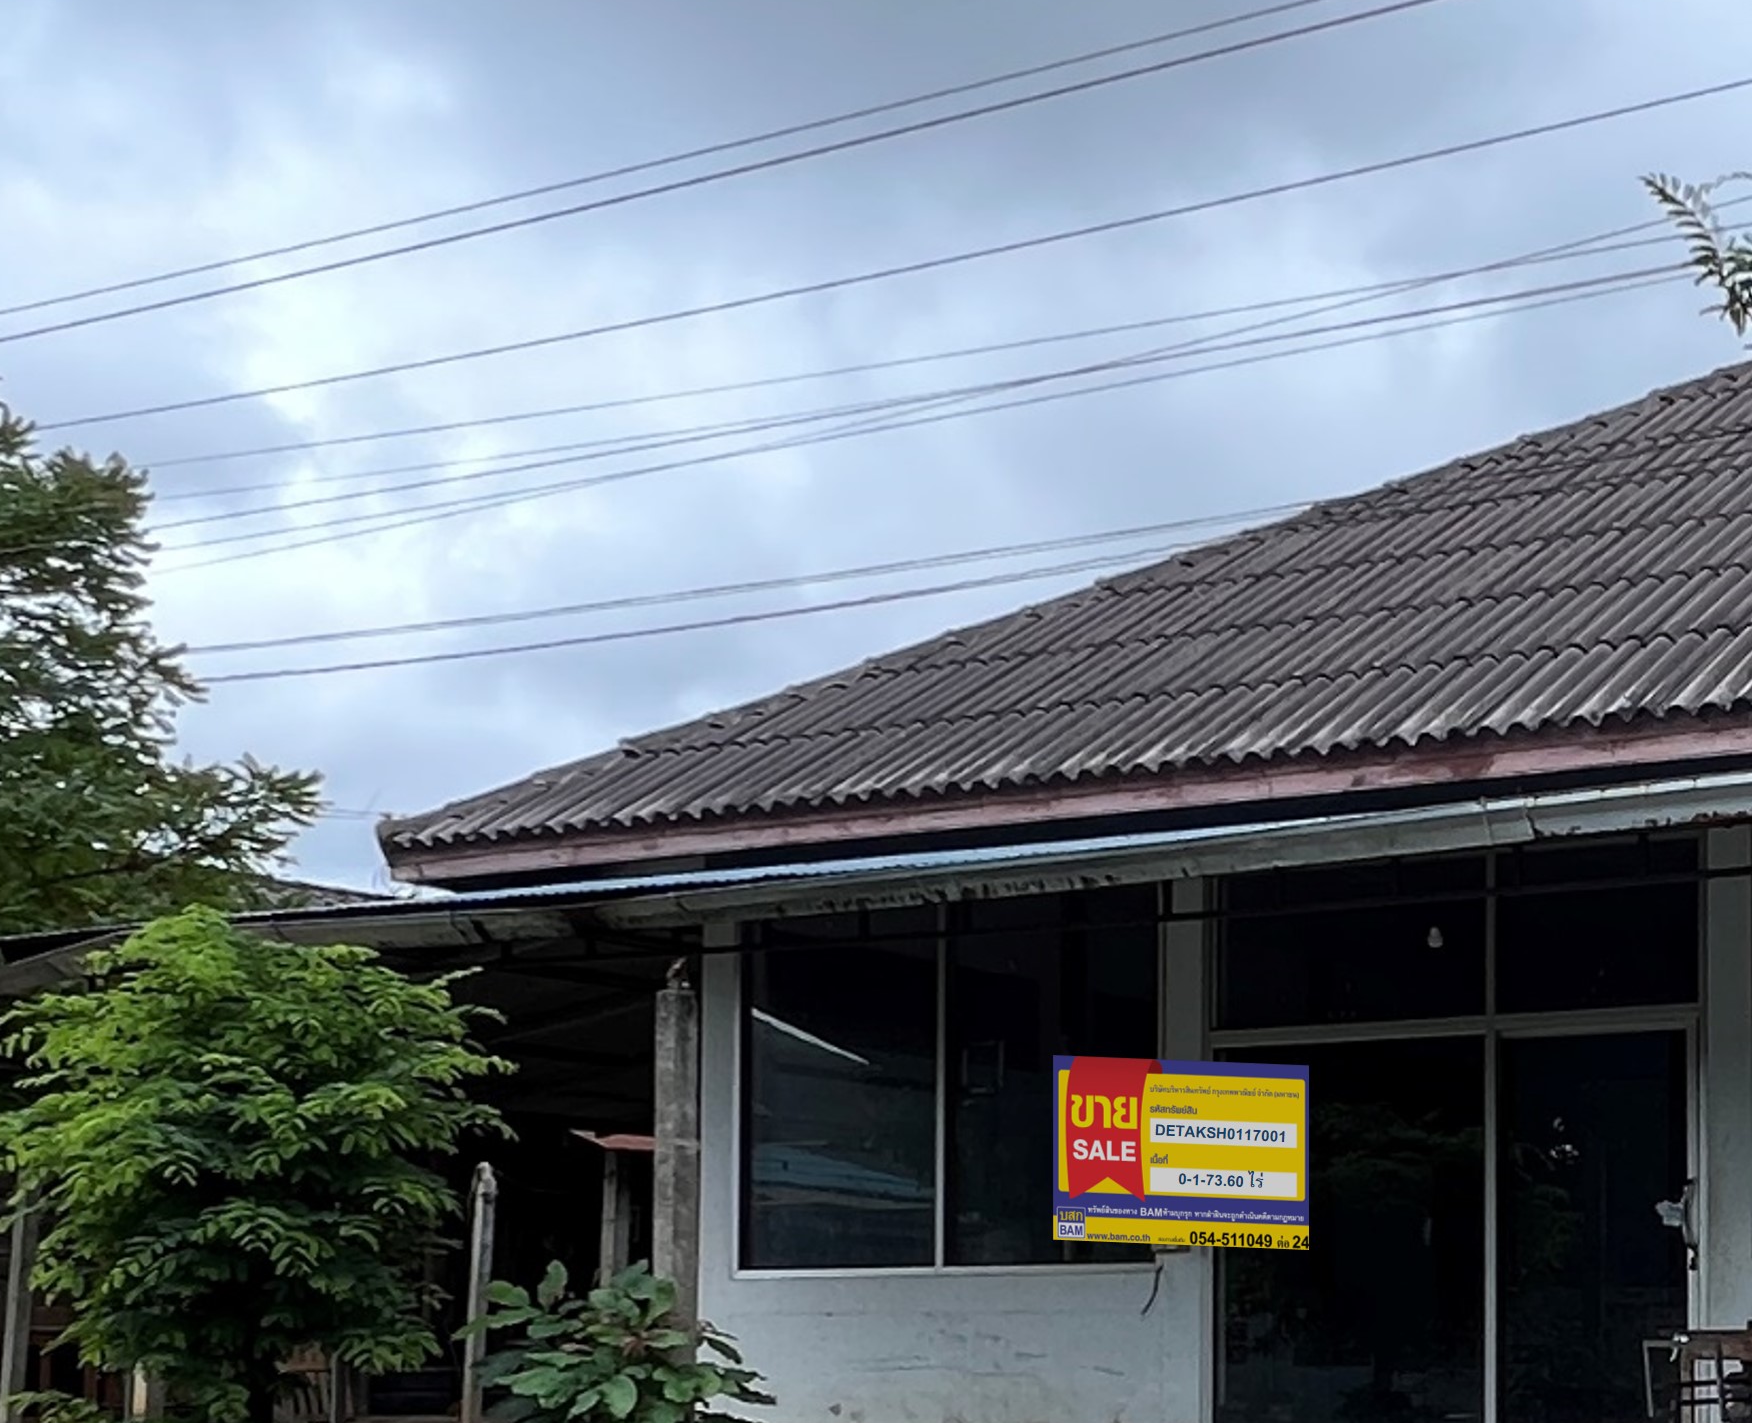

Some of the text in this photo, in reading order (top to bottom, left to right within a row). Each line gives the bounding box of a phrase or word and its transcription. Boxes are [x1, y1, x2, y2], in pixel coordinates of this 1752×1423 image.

[1071, 1094, 1138, 1129] ขาย
[1155, 1124, 1286, 1142] DETAKSH0117001
[1073, 1139, 1136, 1162] SALE
[1178, 1170, 1264, 1188] 0-1-73.60 ไร่
[1059, 1210, 1083, 1221] บสก
[1140, 1207, 1163, 1217] BAM
[1060, 1225, 1083, 1236] BAM
[1087, 1232, 1151, 1242] www.bam.co.th
[1189, 1231, 1273, 1248] 054-511049
[1292, 1235, 1309, 1249] 24
